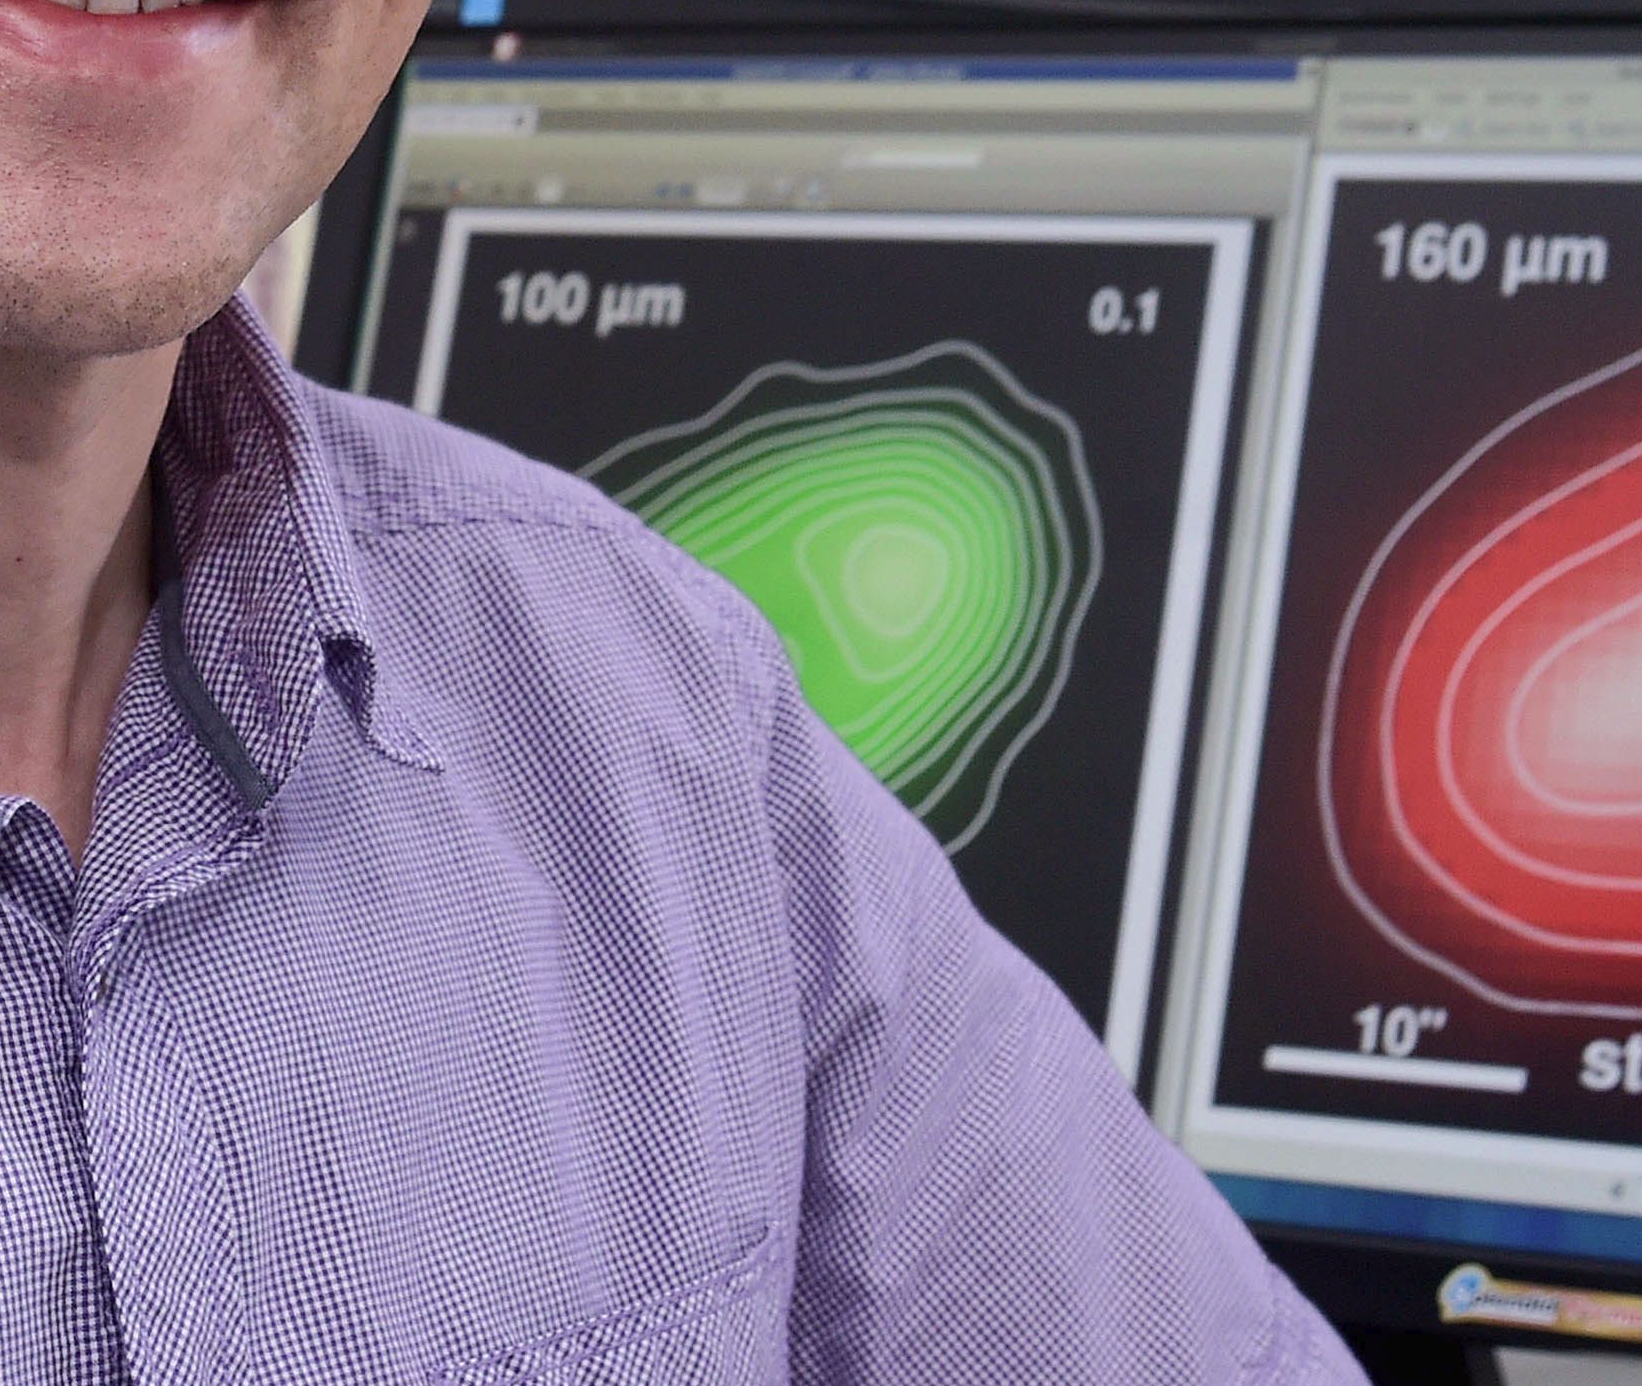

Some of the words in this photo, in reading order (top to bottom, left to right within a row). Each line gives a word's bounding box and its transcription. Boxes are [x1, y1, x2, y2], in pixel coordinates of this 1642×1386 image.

[1375, 220, 1490, 283] 160
[496, 269, 590, 327] 100
[1086, 284, 1162, 335] 0.1
